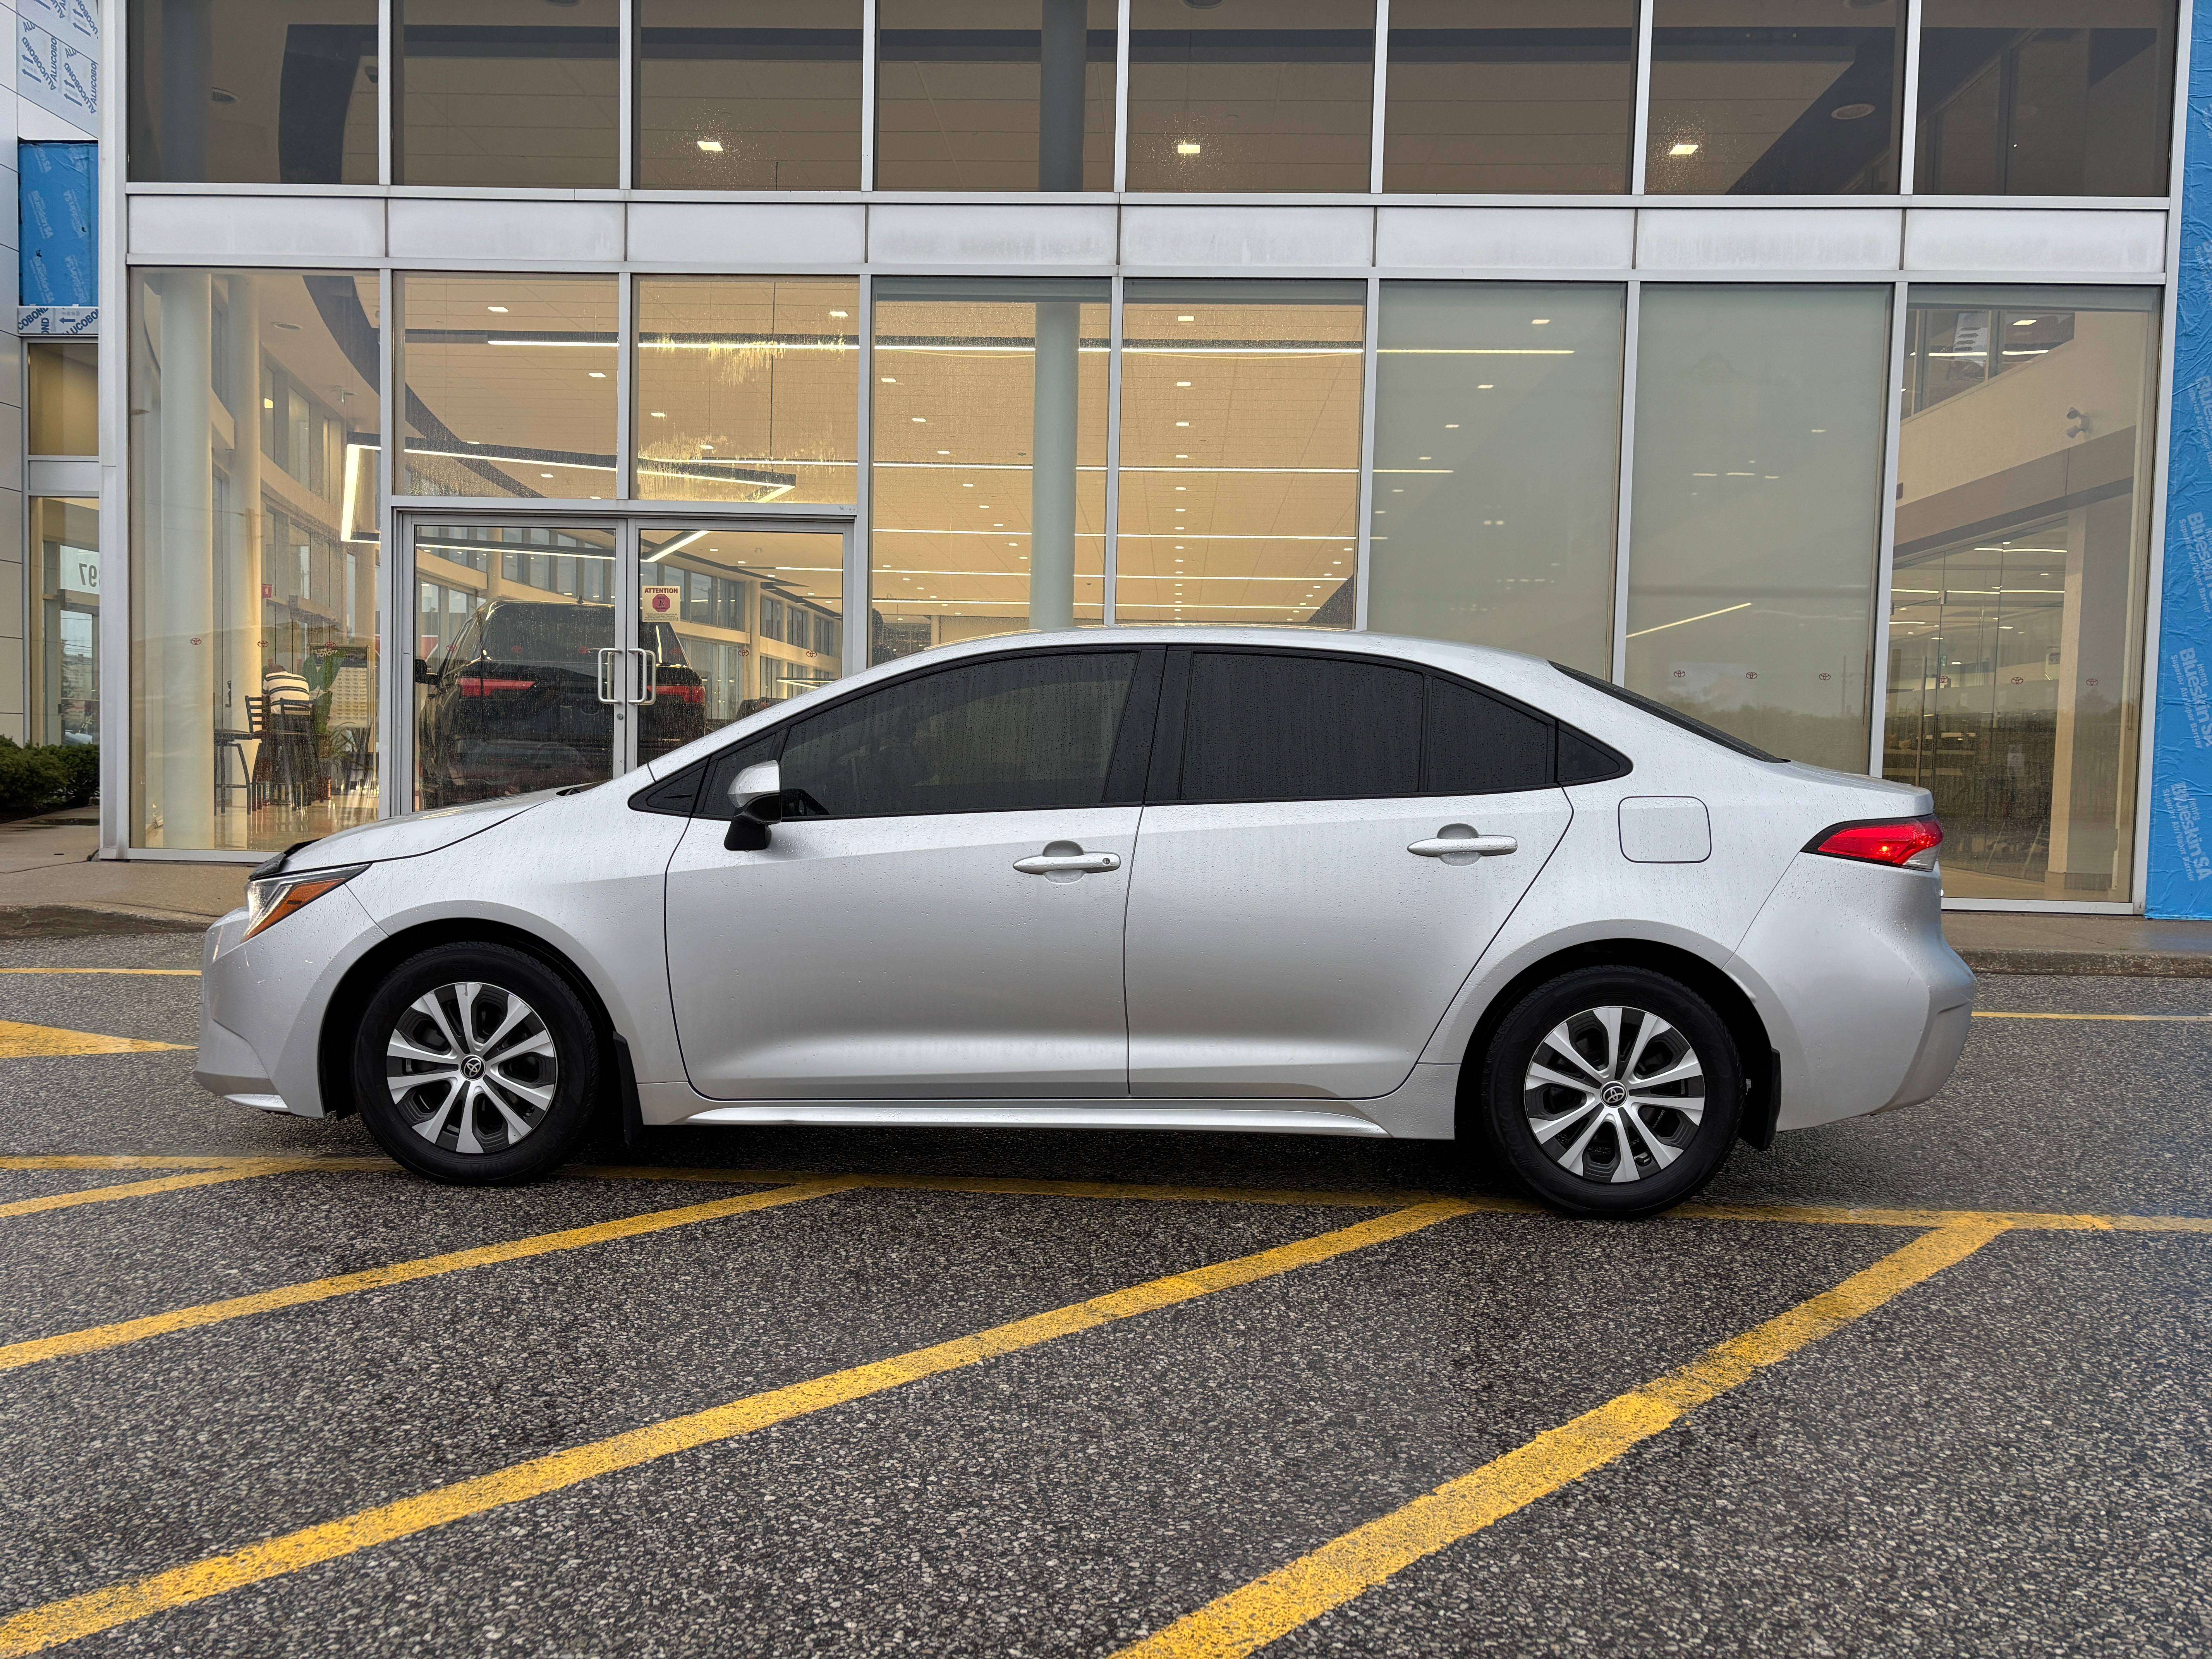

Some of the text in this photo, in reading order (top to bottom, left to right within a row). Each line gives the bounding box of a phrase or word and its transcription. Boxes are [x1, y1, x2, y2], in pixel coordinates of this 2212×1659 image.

[51, 0, 65, 18] ALU
[22, 37, 57, 91] ALUCOBOND
[64, 63, 96, 114] ALUCOBOND
[2170, 654, 2185, 686] Superior
[2179, 647, 2212, 723] Blueskin
[2195, 663, 2209, 687] Henry
